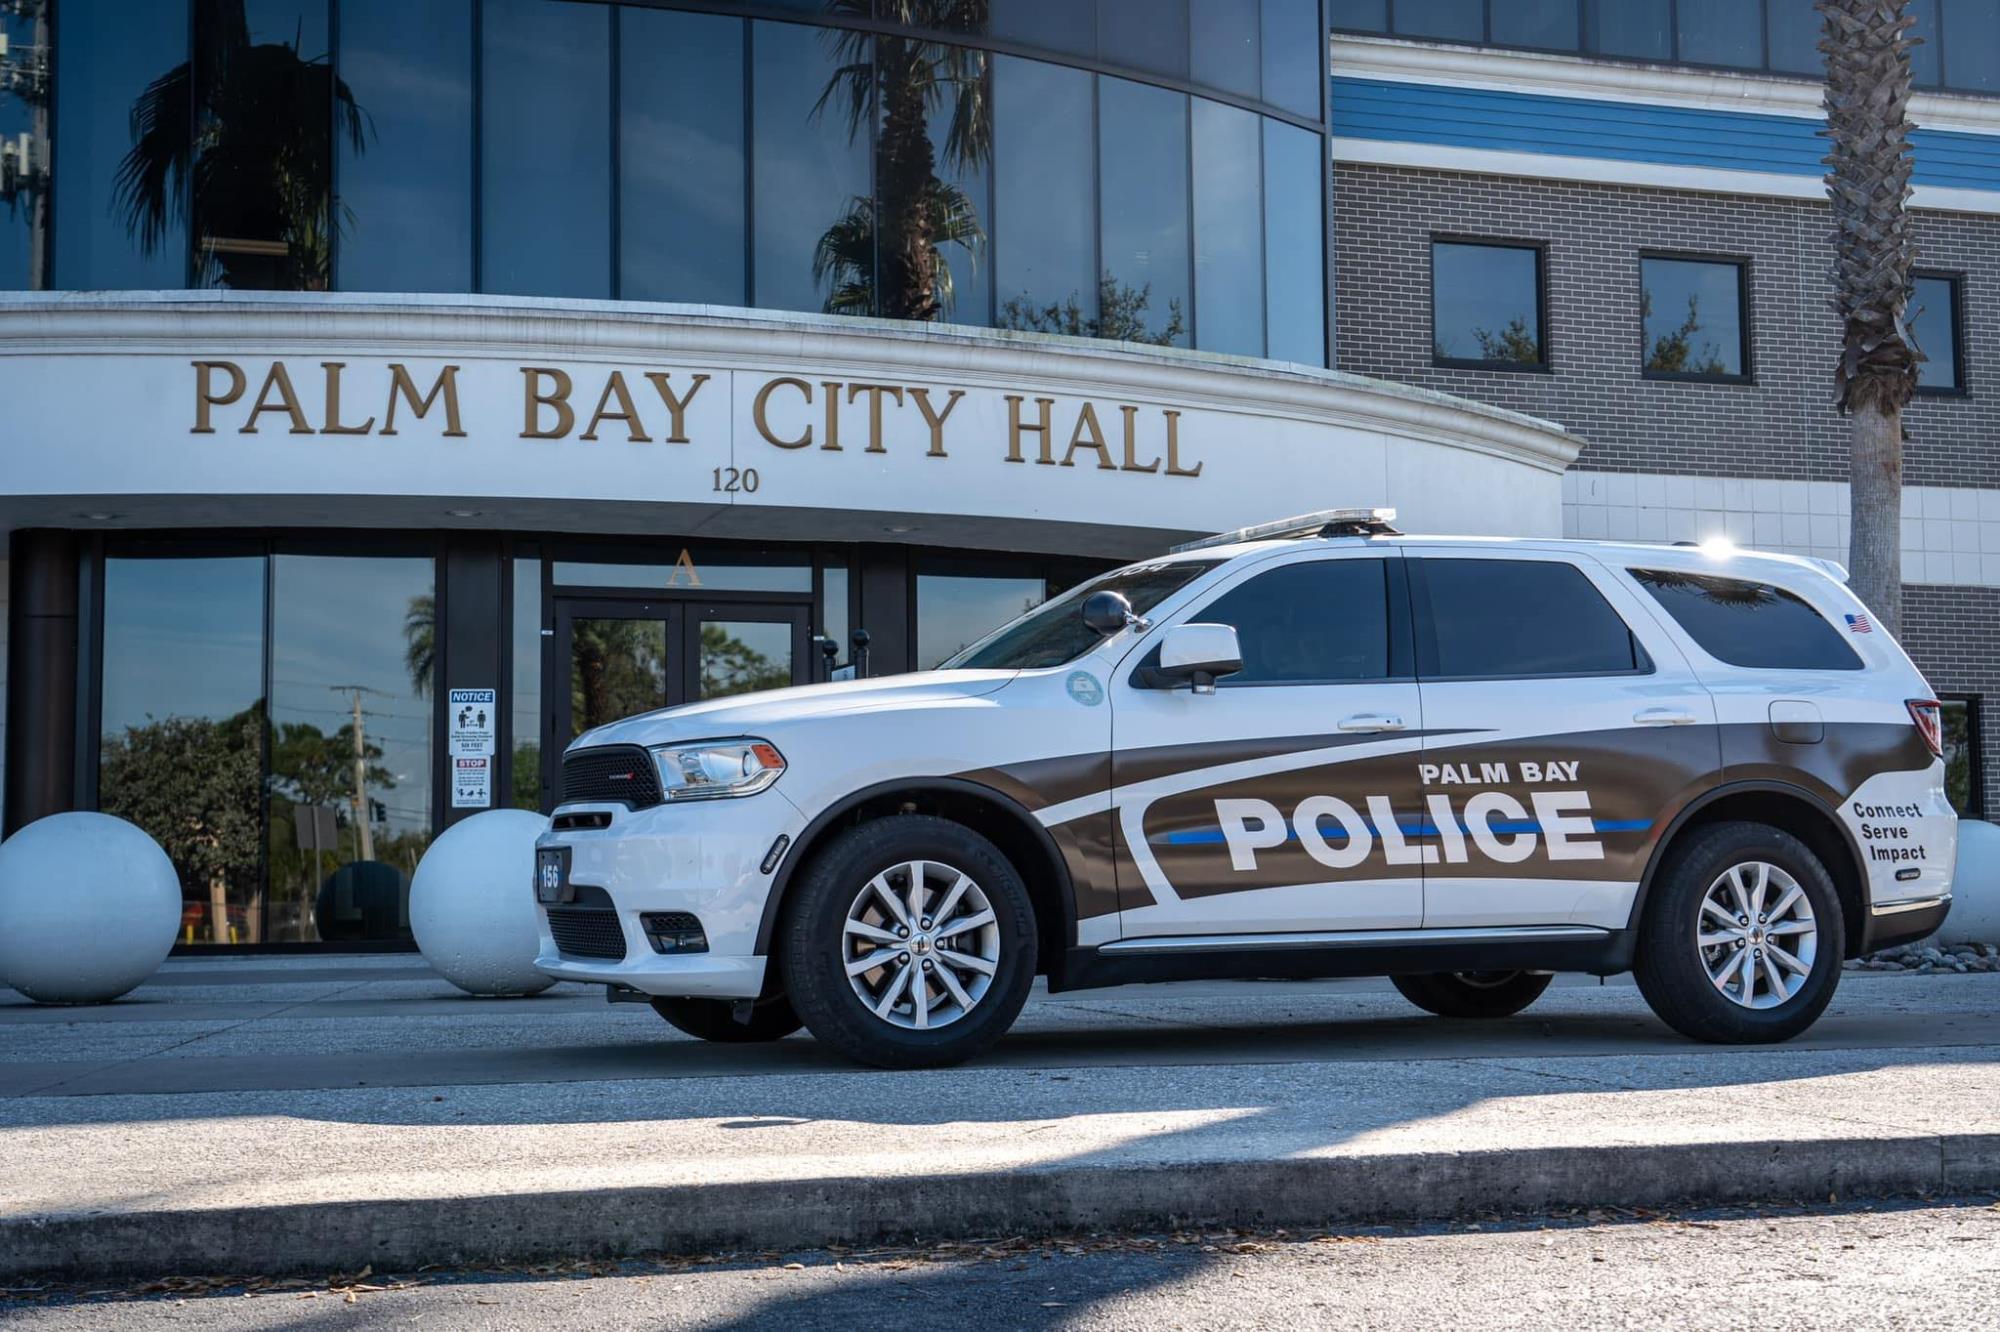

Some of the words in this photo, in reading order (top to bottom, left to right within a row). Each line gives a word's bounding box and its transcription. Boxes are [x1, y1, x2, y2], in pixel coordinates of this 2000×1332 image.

[190, 360, 468, 437] PALM
[518, 366, 711, 444] BAY
[752, 376, 966, 458] CITY
[1003, 394, 1203, 477] HALL
[712, 467, 760, 493] 120
[665, 548, 704, 586] A
[452, 692, 492, 702] NOTICE
[458, 759, 485, 768] STOP
[1417, 762, 1510, 785] PALM
[1519, 760, 1580, 783] BAY
[1853, 802, 1923, 818] Connect
[1214, 790, 1606, 871] POLICE
[1861, 823, 1909, 839] Serve
[1870, 845, 1927, 863] Impact
[542, 864, 558, 888] 156
